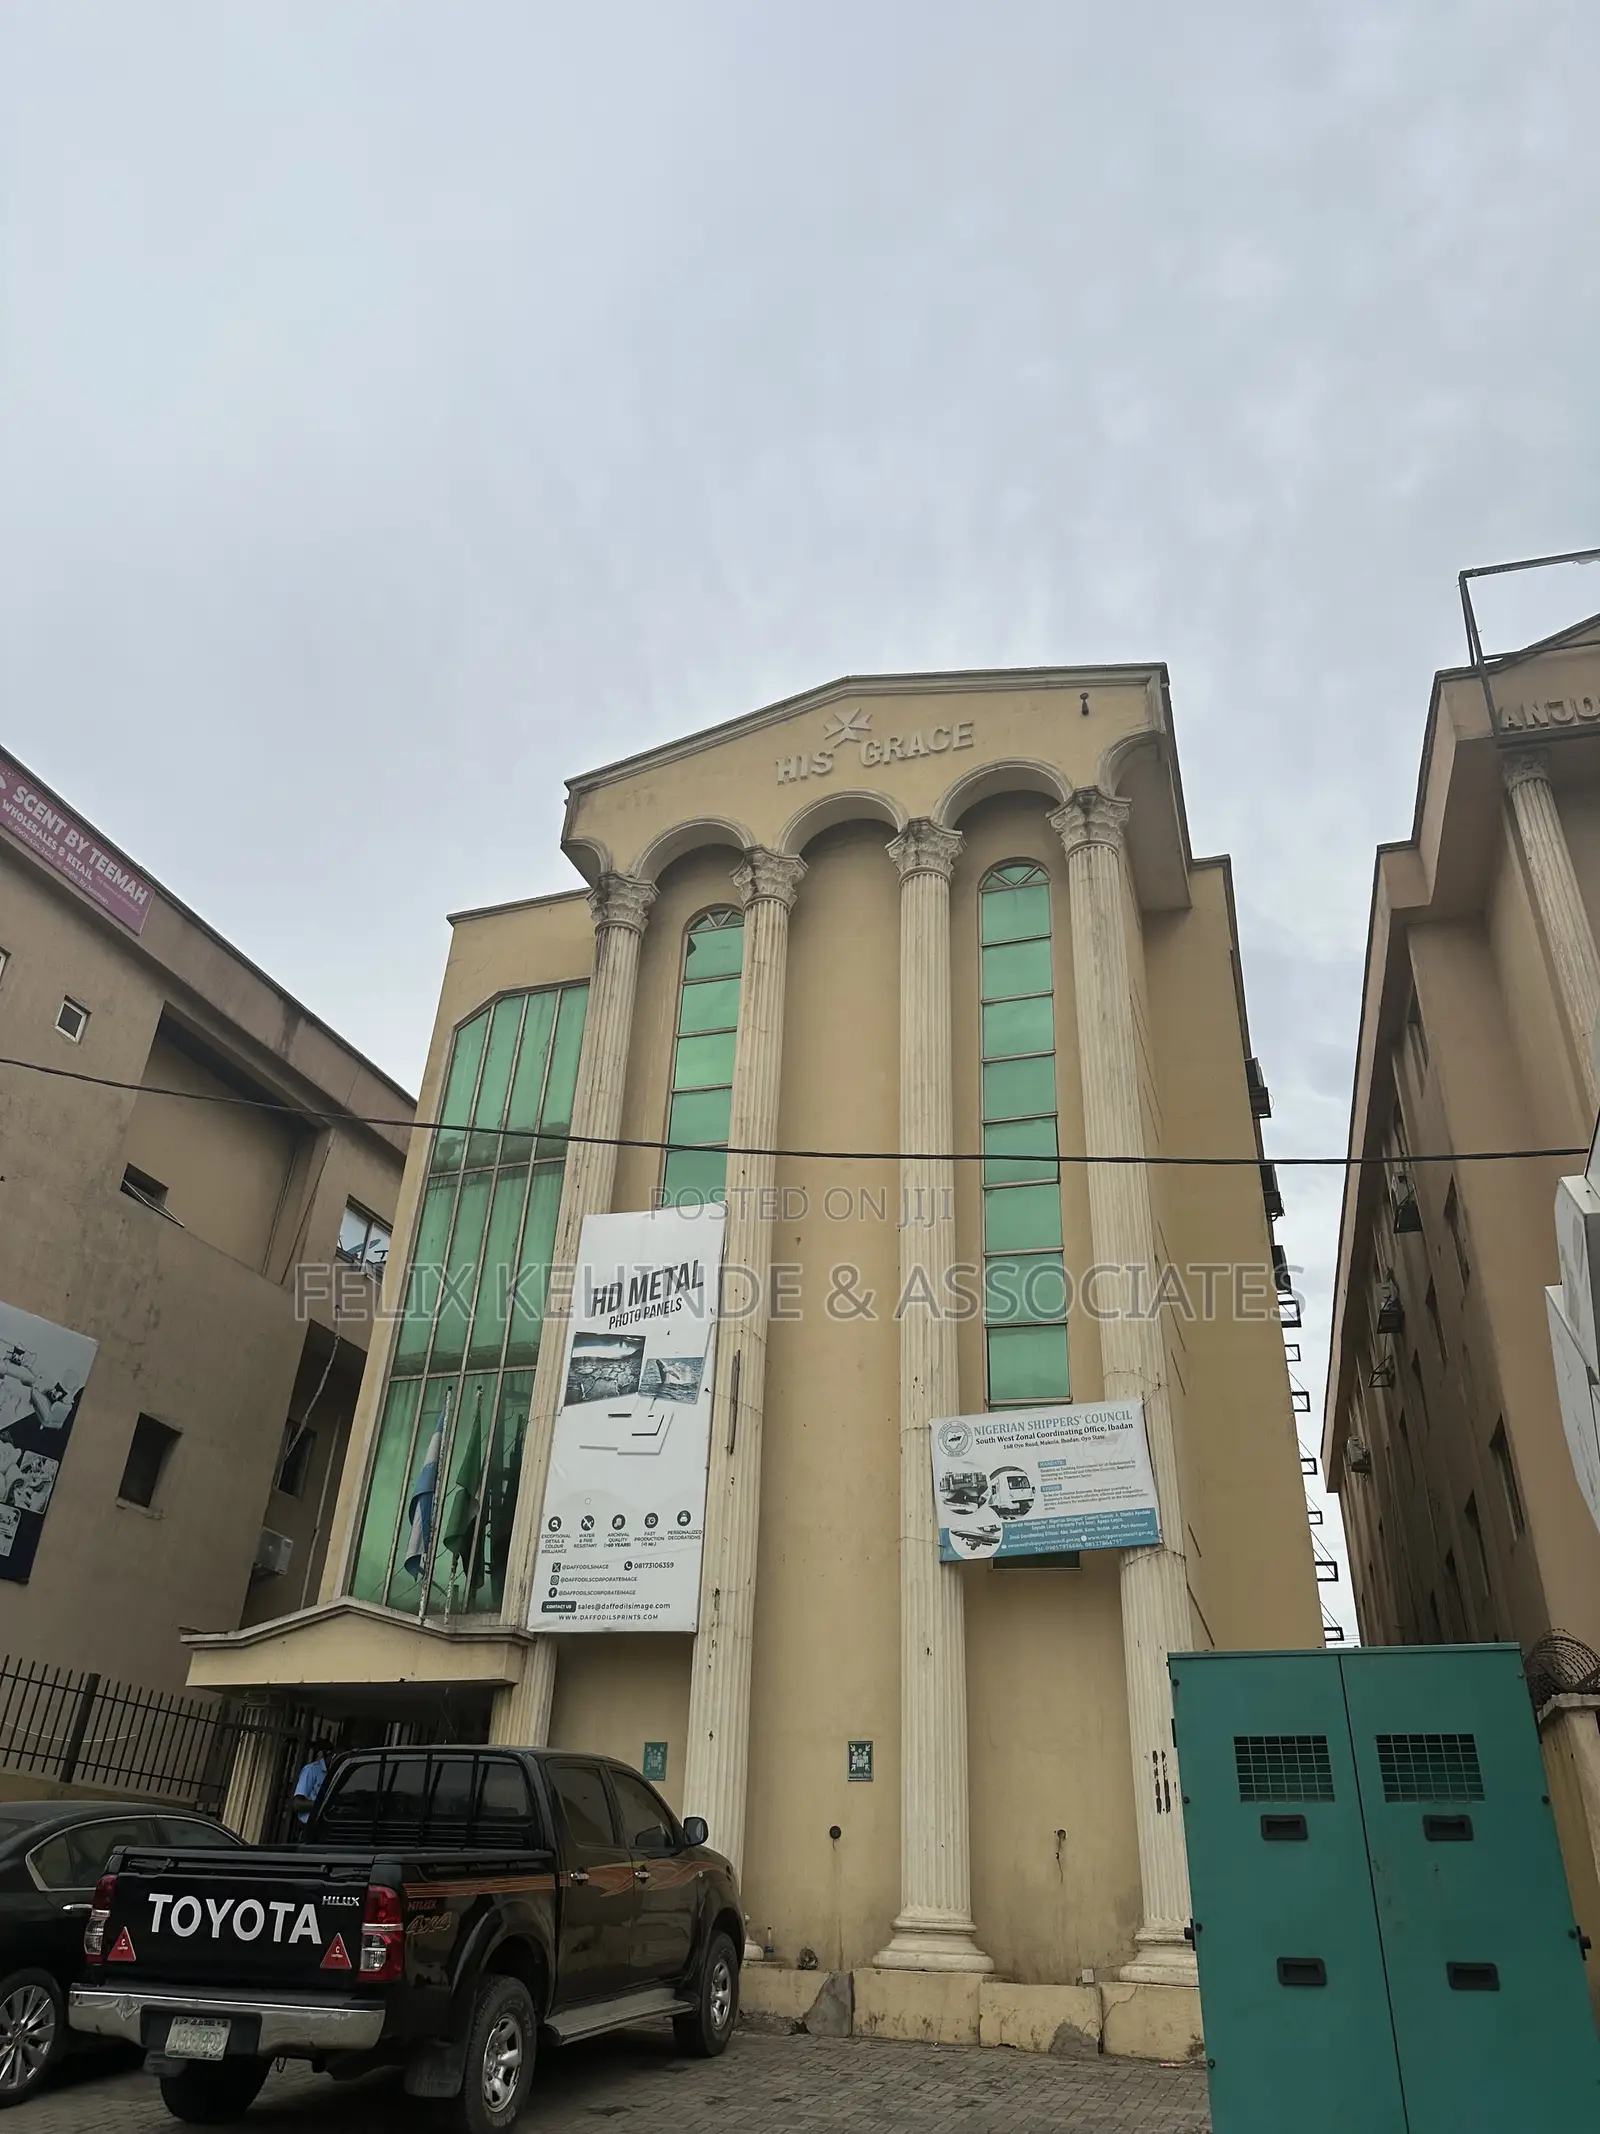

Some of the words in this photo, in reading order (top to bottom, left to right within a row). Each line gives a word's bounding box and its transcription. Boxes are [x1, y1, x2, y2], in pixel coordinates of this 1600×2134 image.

[776, 750, 835, 785] HIS
[860, 719, 975, 767] GRACE
[2, 799, 58, 851] WHOLESALES
[66, 853, 93, 881] RETAIL
[13, 785, 67, 835] SCENT
[64, 829, 90, 854] BY
[88, 847, 149, 905] TEEMAH
[590, 1281, 623, 1318] HD
[628, 1259, 704, 1307] METAL
[609, 1308, 641, 1330] PHOTO
[644, 1298, 682, 1320] PANELS
[974, 1422, 1025, 1436] NIGERIAN
[1028, 1415, 1082, 1430] SHIPPERS'
[1084, 1410, 1133, 1424] COUNCIL
[976, 1435, 996, 1445] South
[997, 1433, 1014, 1442] West
[1015, 1432, 1035, 1440] Zonal
[1036, 1427, 1083, 1439] Coordinating
[1084, 1424, 1106, 1434] Office,
[1108, 1422, 1133, 1431] Ibadan
[634, 1561, 674, 1569] 08173106359
[578, 1602, 671, 1610] sales@daffodilsimage.com
[322, 1895, 360, 1907] HILUX
[148, 1893, 322, 1945] TOYOTA
